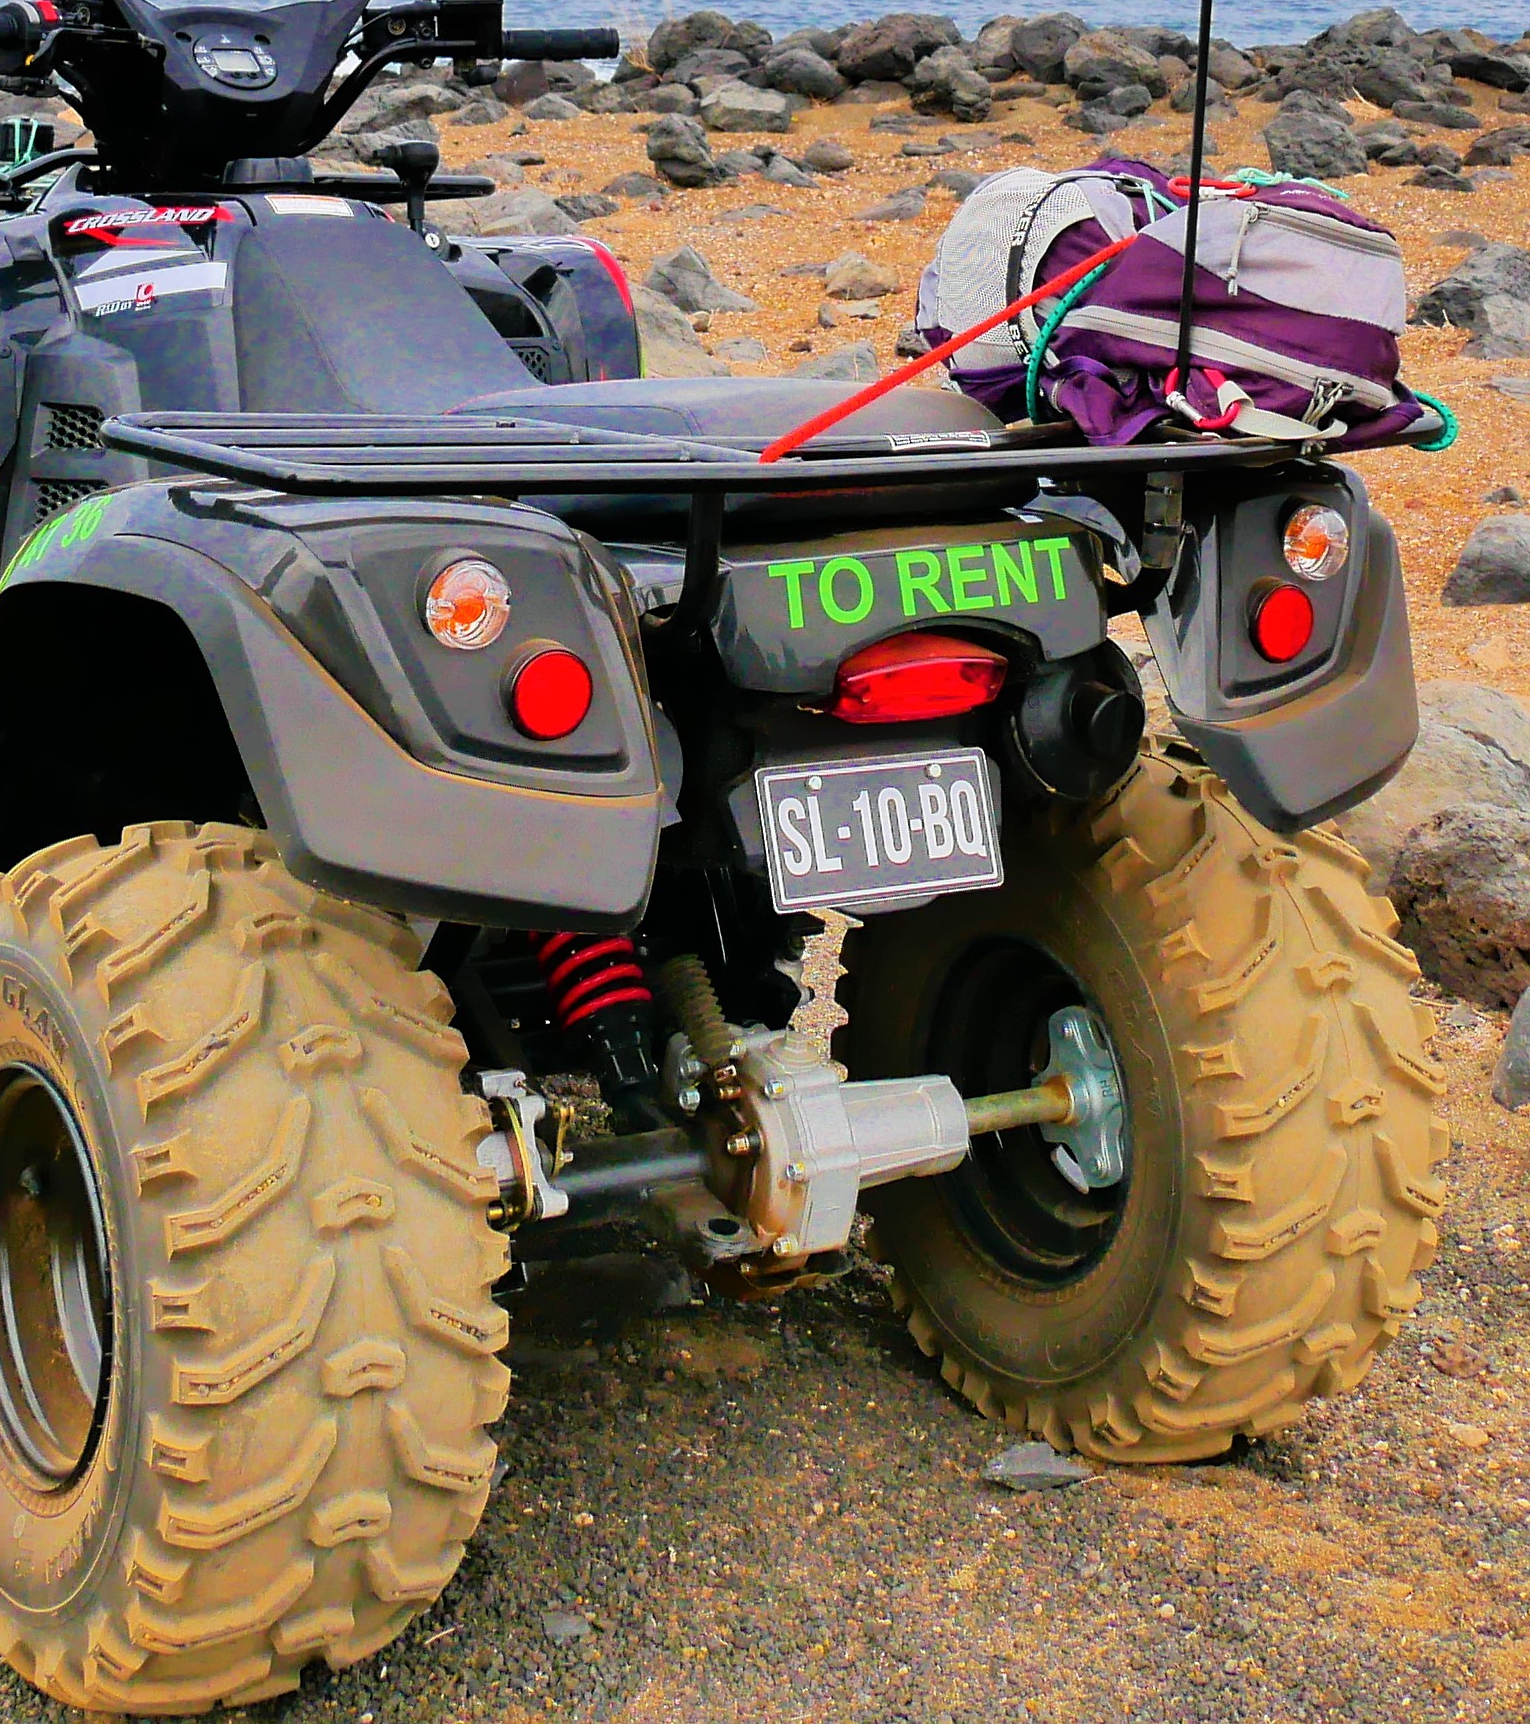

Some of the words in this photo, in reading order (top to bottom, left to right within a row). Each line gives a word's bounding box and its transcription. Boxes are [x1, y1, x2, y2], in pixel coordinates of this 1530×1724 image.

[67, 207, 216, 234] CROSSLAND
[1009, 323, 1033, 366] BE
[767, 556, 875, 630] TO
[894, 537, 1071, 618] RENT
[777, 778, 989, 877] SL-10-BQ
[1, 974, 70, 1066] CLAW
